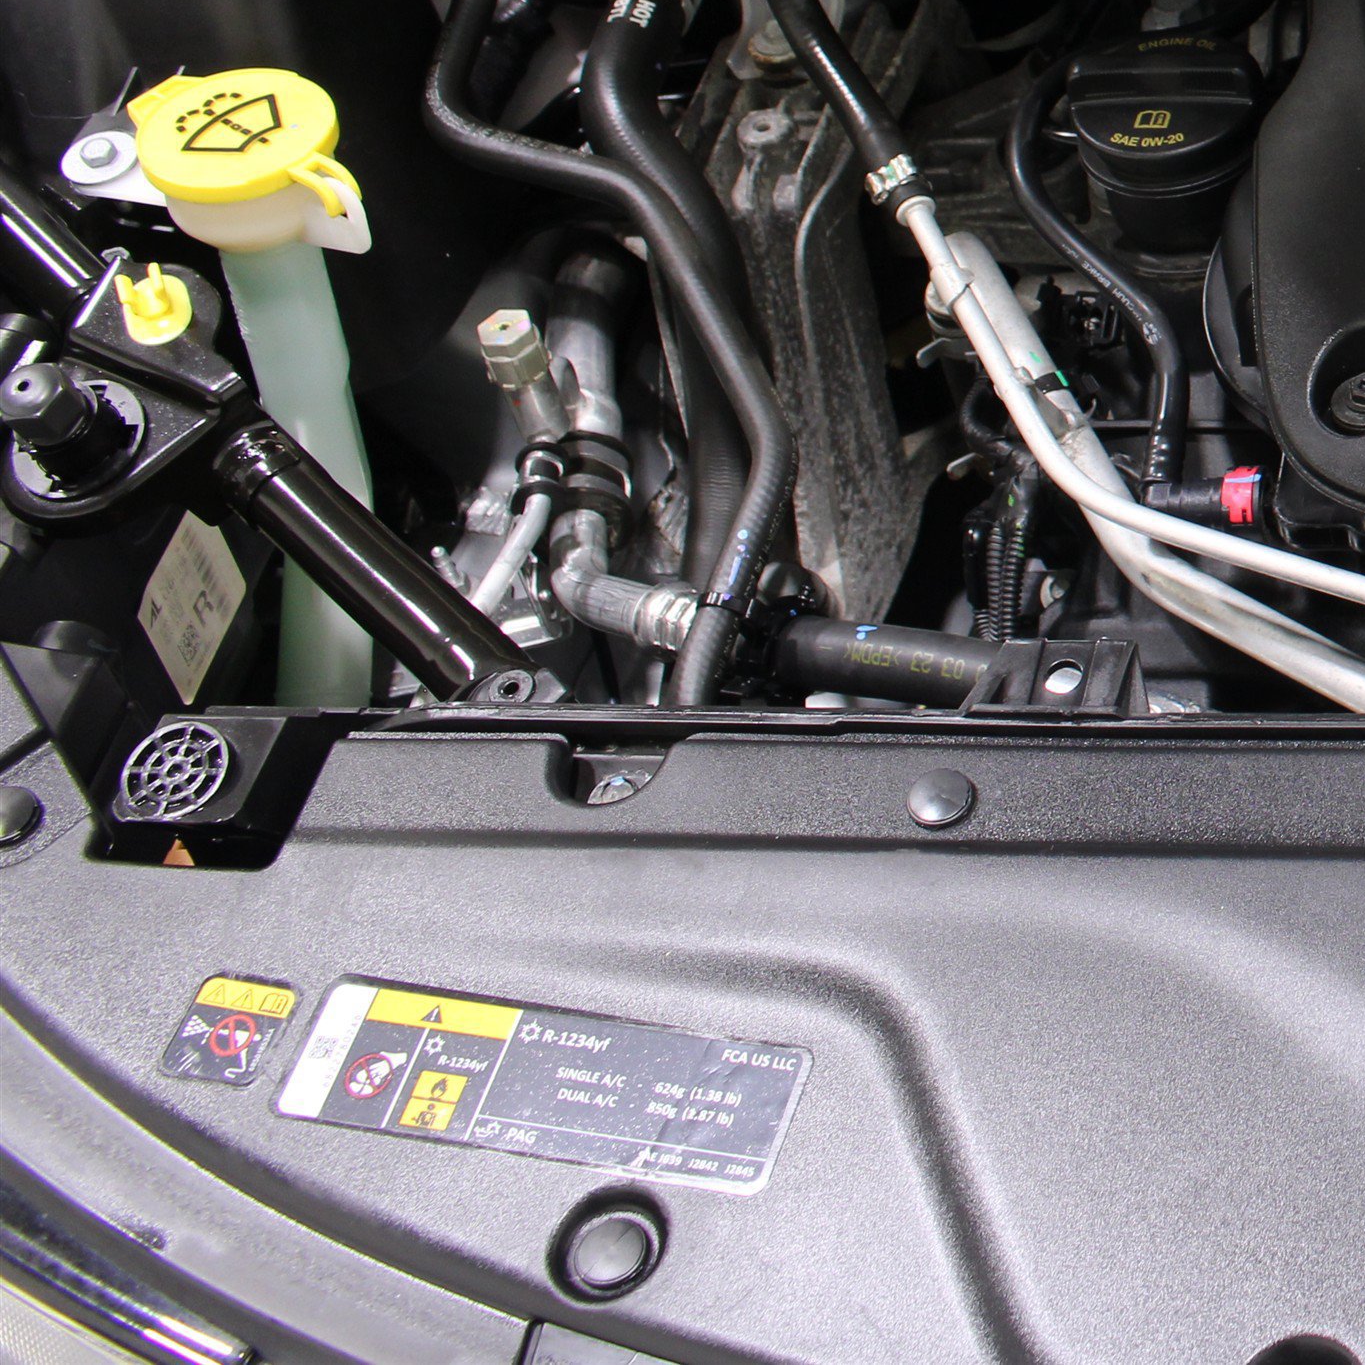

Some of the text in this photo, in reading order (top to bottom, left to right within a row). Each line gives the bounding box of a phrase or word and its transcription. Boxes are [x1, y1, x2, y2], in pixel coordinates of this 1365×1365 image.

[1138, 37, 1217, 52] ENGINE OIL
[1110, 132, 1185, 147] SAE 0W-20
[541, 1029, 612, 1053] R-1234yf
[437, 1055, 489, 1074] R-1234yf
[721, 1048, 797, 1071] FCA US LLC
[556, 1066, 627, 1088] SINGLE A/C
[557, 1088, 618, 1109] DUAL A/C
[723, 1093, 742, 1108] lb)
[716, 1113, 735, 1129] lb)
[505, 1127, 538, 1145] PAG
